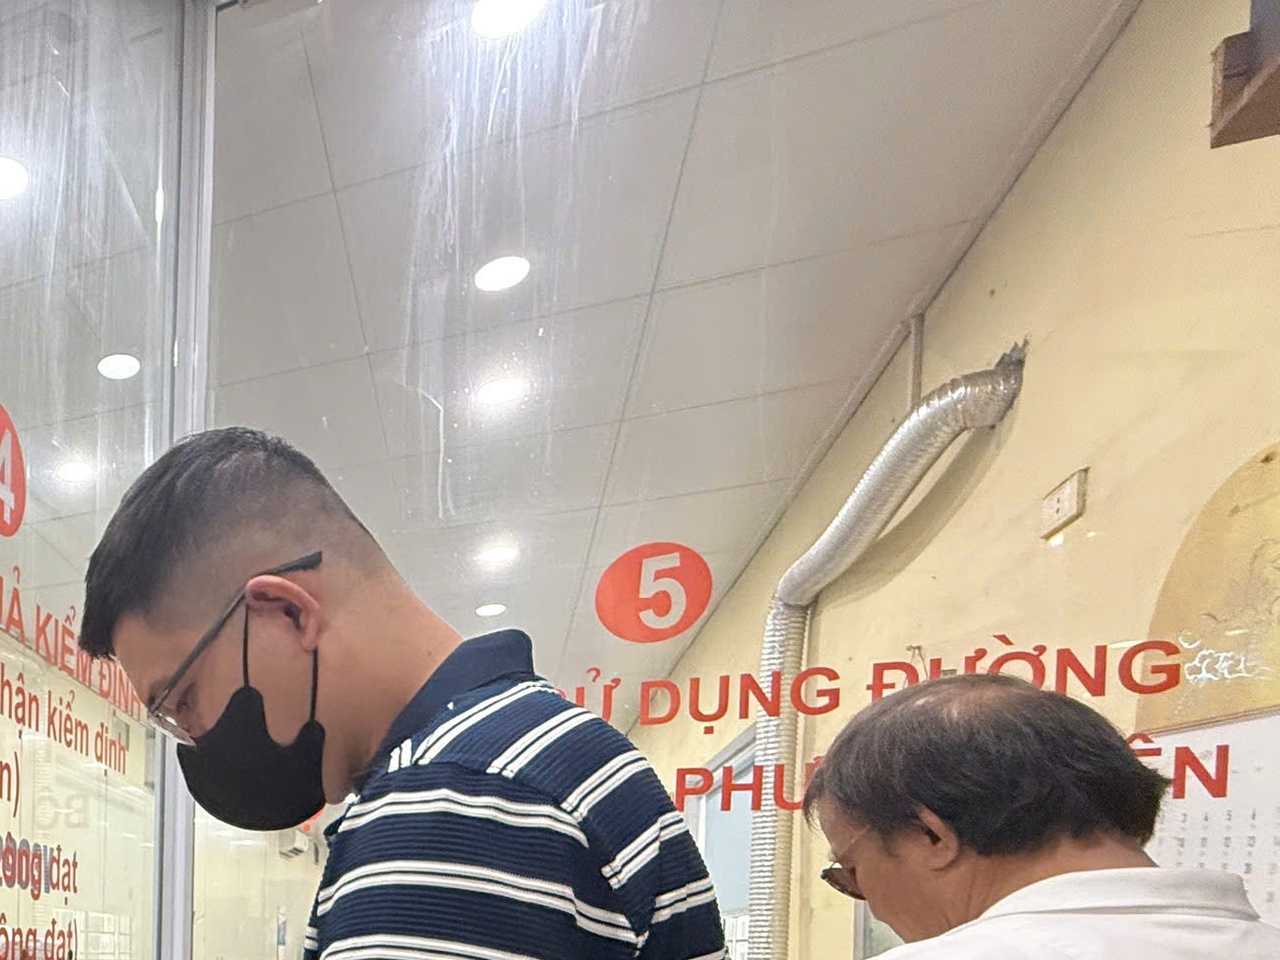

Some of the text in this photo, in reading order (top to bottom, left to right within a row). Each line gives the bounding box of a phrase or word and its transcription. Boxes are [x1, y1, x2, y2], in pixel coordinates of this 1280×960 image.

[638, 551, 688, 630] 5
[35, 606, 93, 689] KIỂM
[47, 690, 89, 757] kiểm
[558, 667, 621, 722] Ử
[639, 667, 841, 735] DỤNG
[50, 844, 78, 905] đạt
